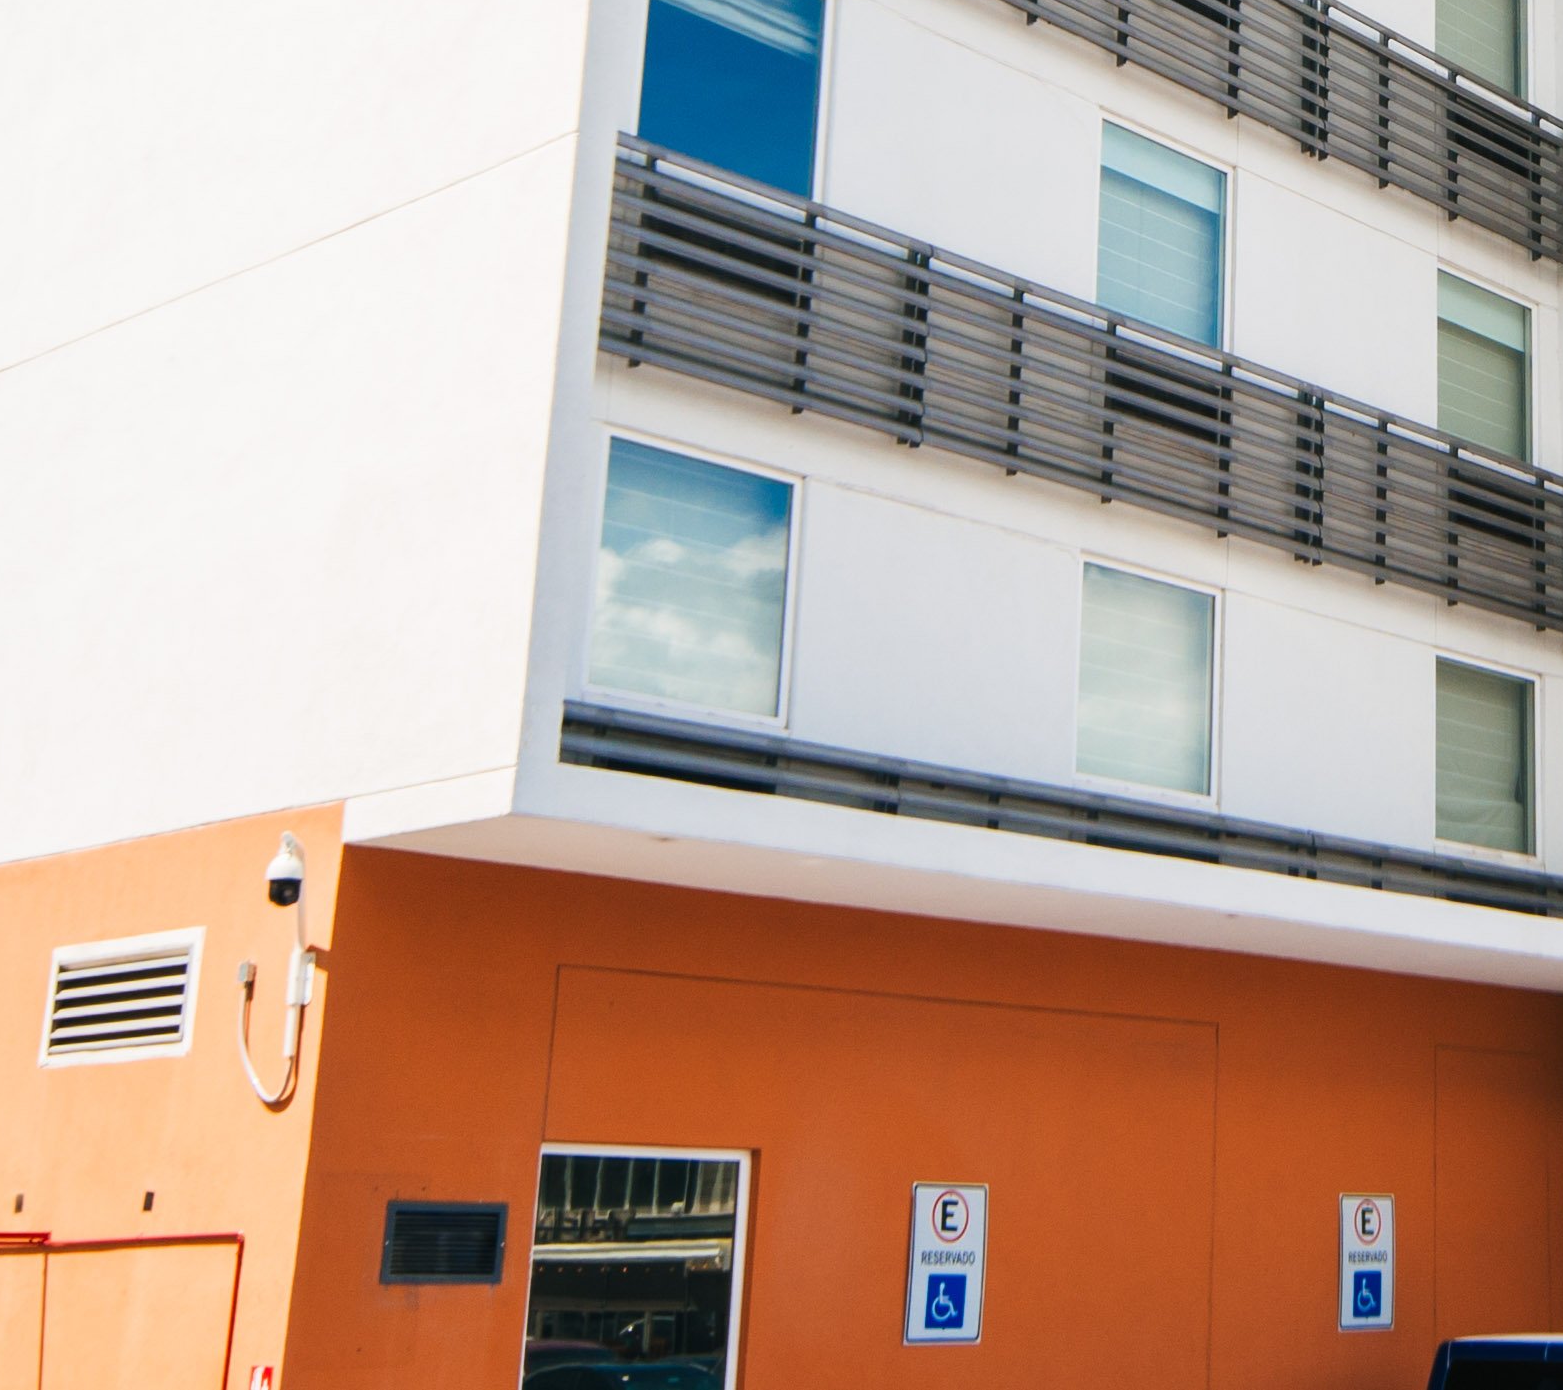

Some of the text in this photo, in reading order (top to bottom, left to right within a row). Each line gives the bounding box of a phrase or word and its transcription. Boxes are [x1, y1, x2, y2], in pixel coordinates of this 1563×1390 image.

[941, 1200, 959, 1231] E
[1361, 1207, 1374, 1235] E
[921, 1251, 976, 1265] RESERVADO
[1348, 1250, 1388, 1263] RESERVADO
